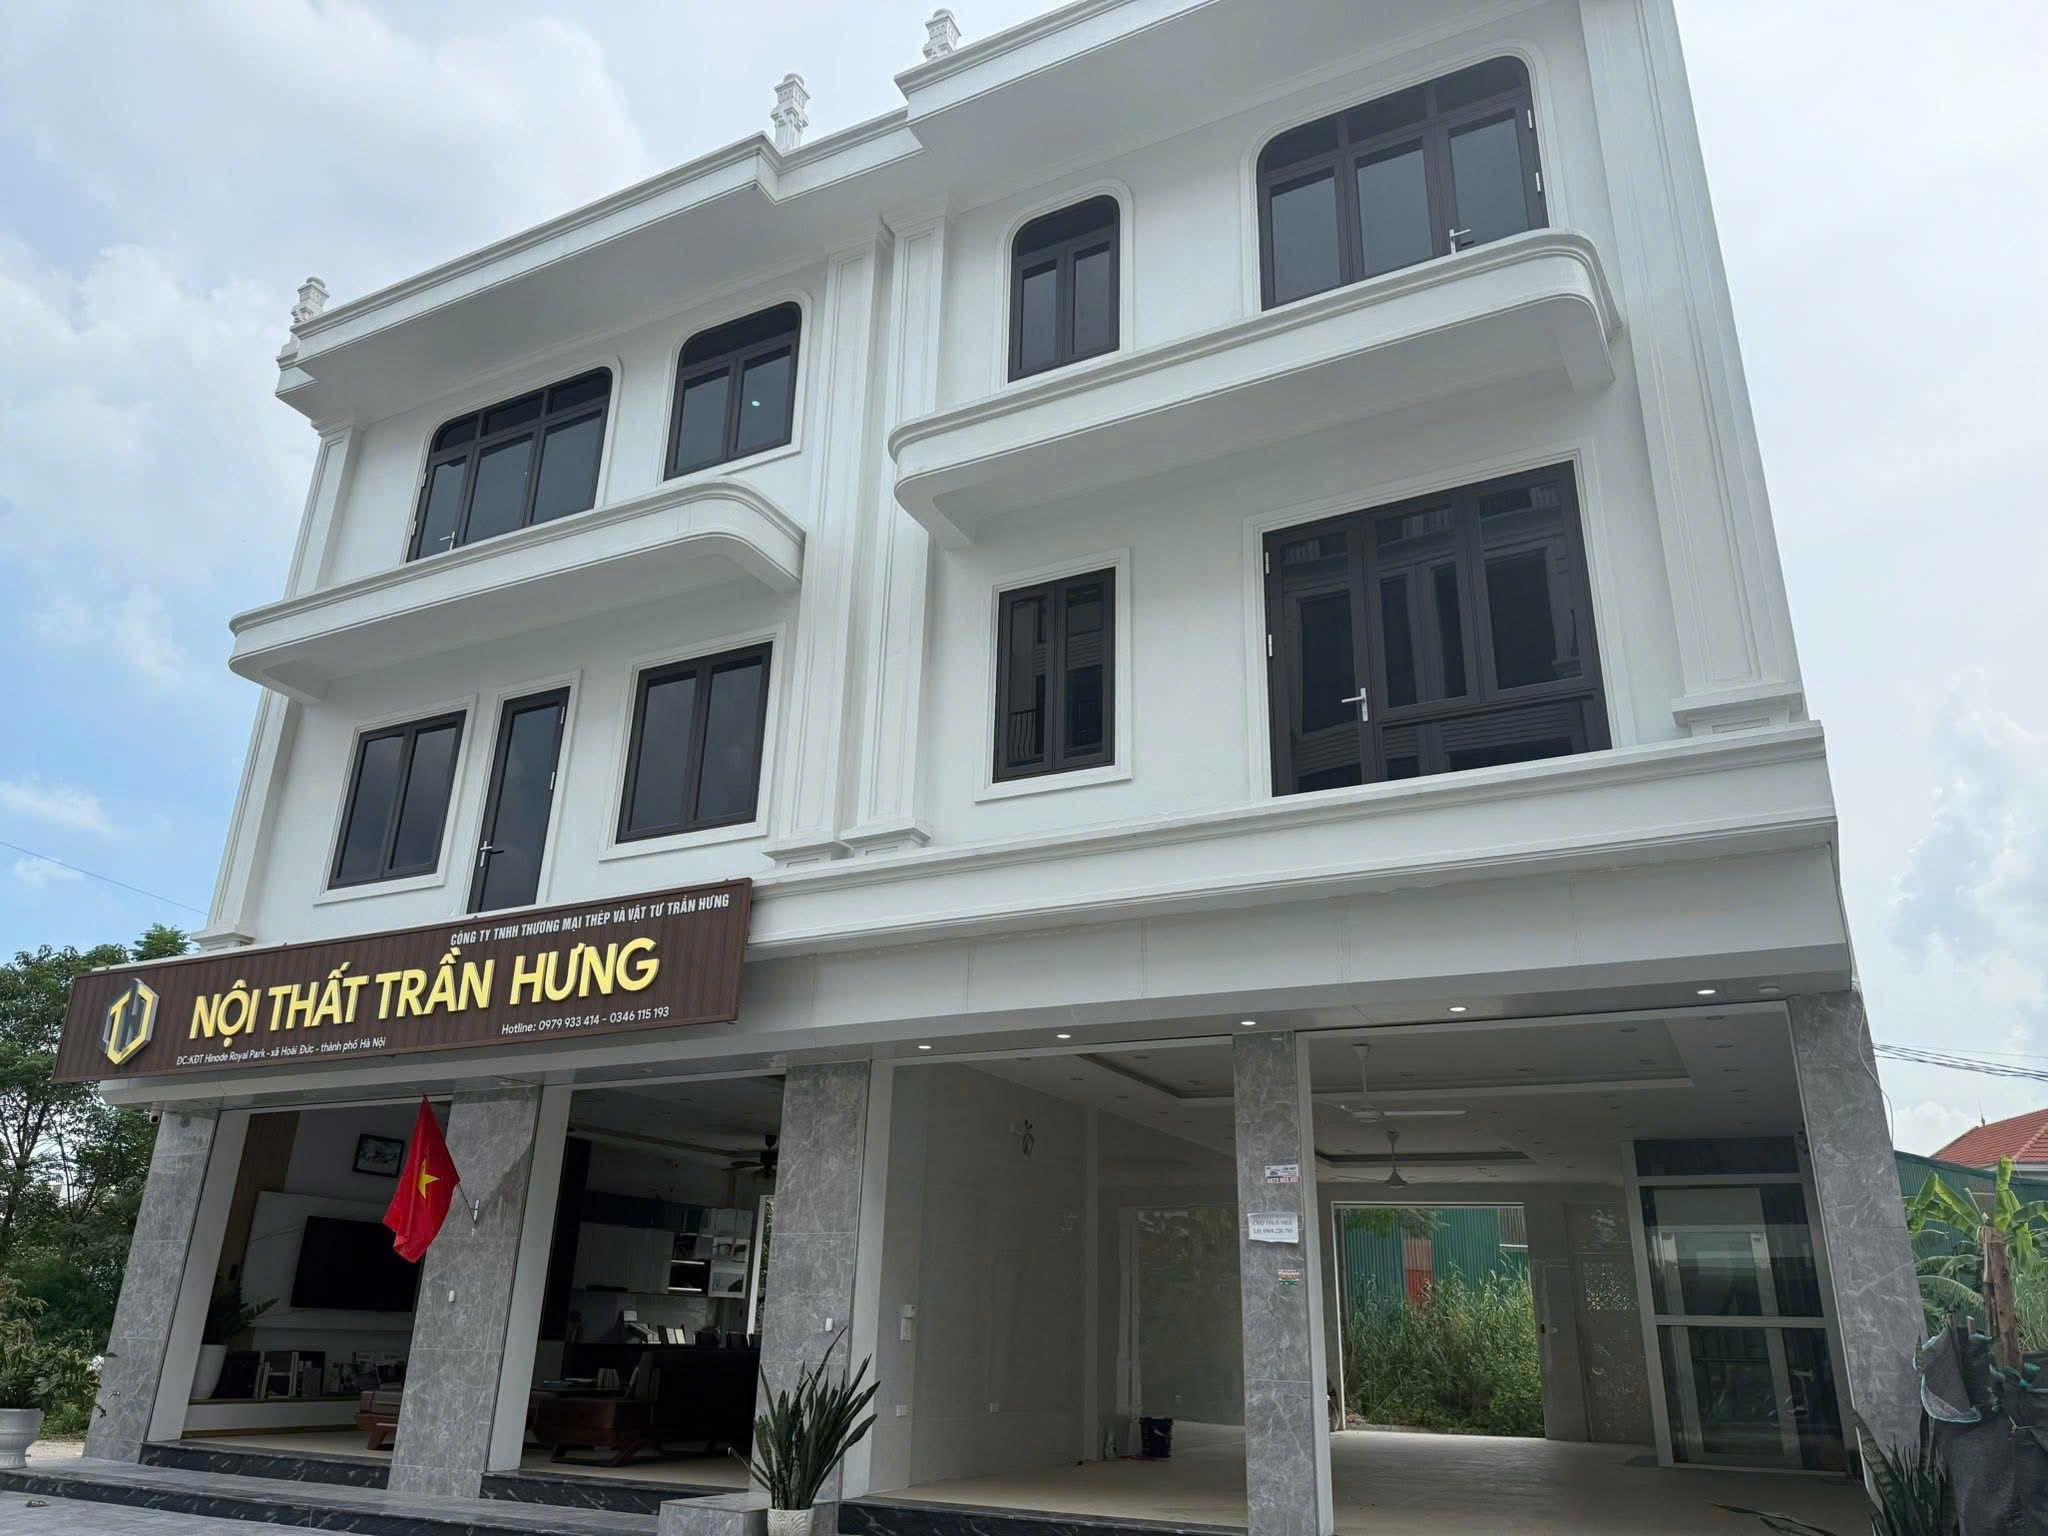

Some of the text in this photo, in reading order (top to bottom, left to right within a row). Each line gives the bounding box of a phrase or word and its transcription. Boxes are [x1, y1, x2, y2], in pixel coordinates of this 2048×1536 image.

[450, 893, 730, 946] CÔNG TY TNHH THƯƠNG MẠI THÉP VÀ VẬT TƯ TRẦN HƯNG
[188, 937, 660, 1048] NỘI THẤT TRẦN HƯNG
[501, 1023, 536, 1035] Hotline:
[538, 1017, 563, 1031] 0979
[564, 1015, 581, 1028] 933
[583, 1014, 600, 1026] 414
[609, 1010, 635, 1023] 0346
[637, 1008, 651, 1020] 115
[653, 1006, 670, 1018] 193
[204, 1053, 229, 1063] Hinode
[230, 1050, 249, 1063] Royal
[249, 1049, 266, 1058] Park
[270, 1047, 280, 1057] xã
[281, 1045, 298, 1056] Hoài
[299, 1044, 314, 1054] Đức
[321, 1041, 342, 1052] thành
[342, 1038, 360, 1053] phố
[360, 1038, 371, 1049] Hà
[372, 1036, 386, 1049] Nội
